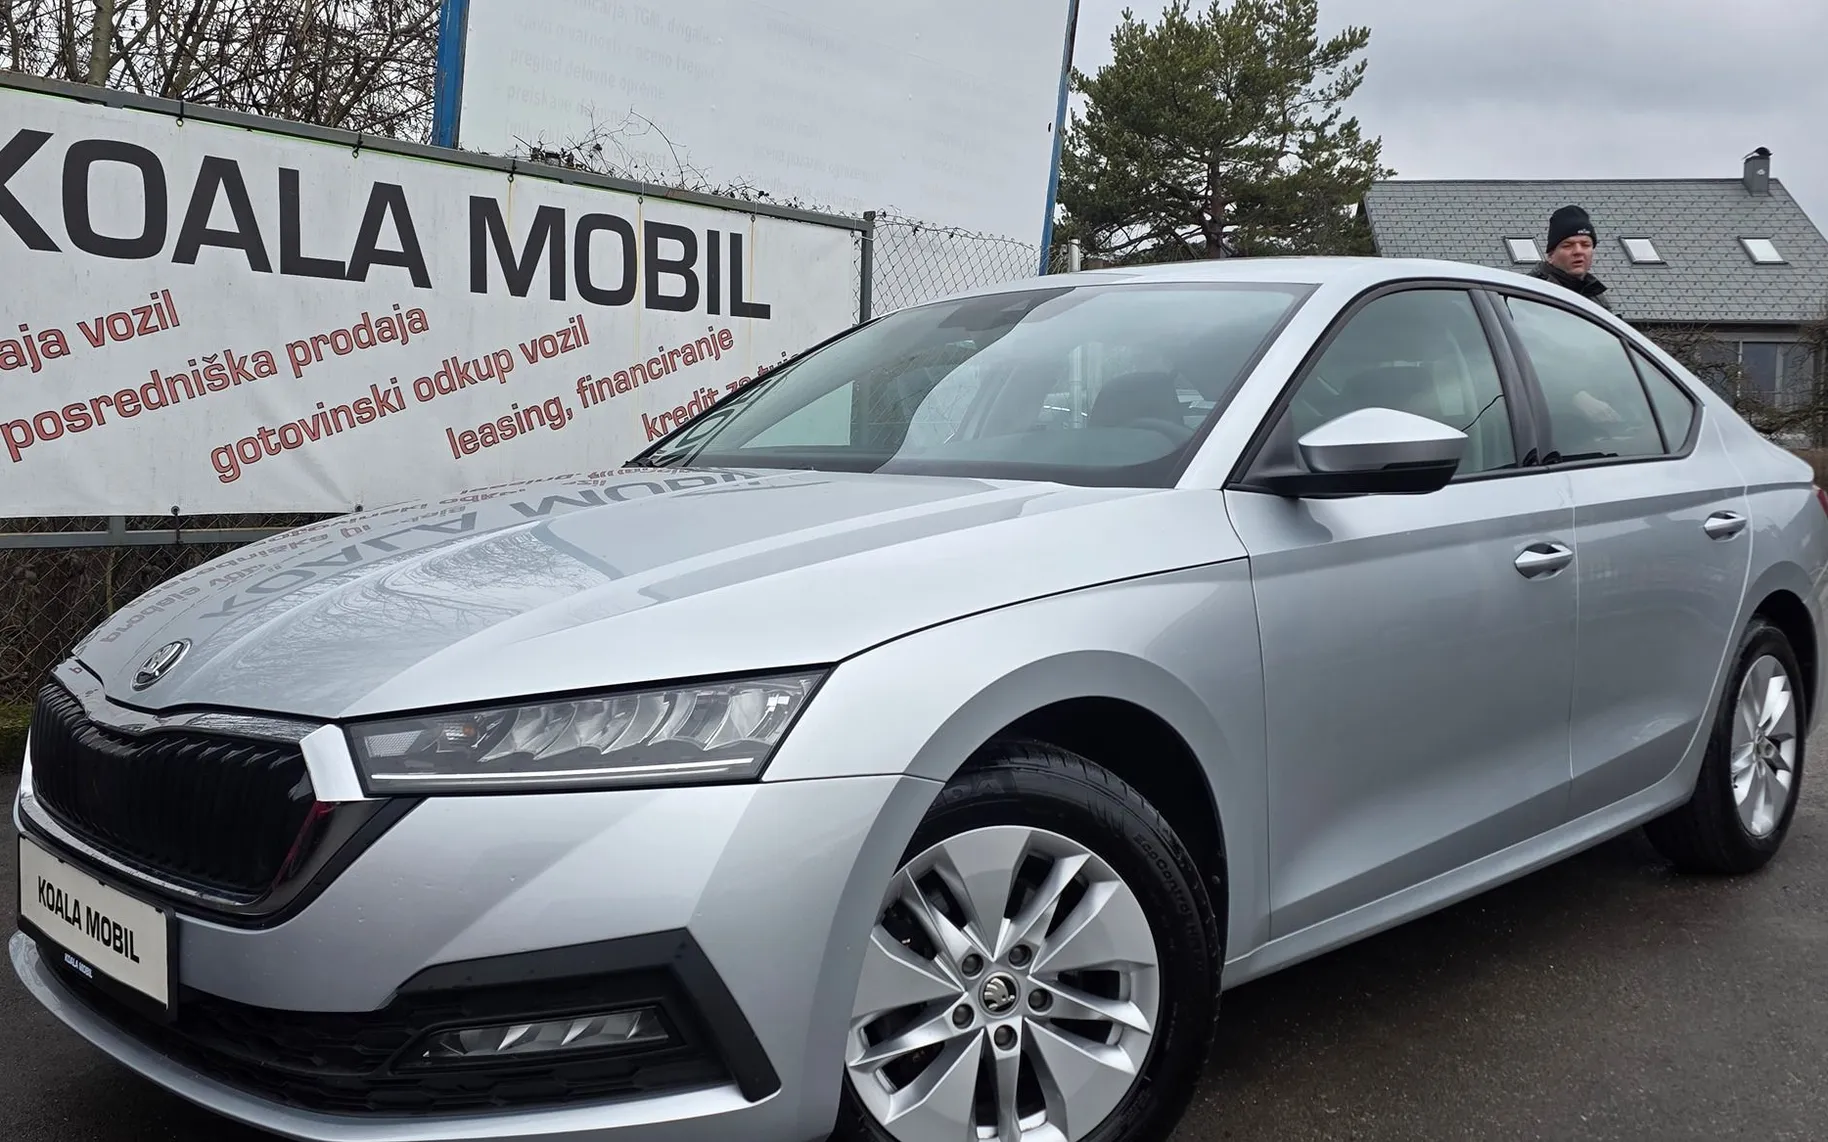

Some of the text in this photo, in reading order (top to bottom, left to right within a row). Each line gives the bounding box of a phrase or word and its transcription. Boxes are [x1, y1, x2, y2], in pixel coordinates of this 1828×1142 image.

[0, 128, 771, 320] KOALA MOBIL
[0, 303, 430, 463] posredniška prodaja
[77, 288, 181, 350] vozil
[210, 376, 407, 484] gotovinski
[413, 347, 514, 404] odkup
[519, 314, 591, 365] vozil
[446, 325, 735, 460] leasing, financiranje
[641, 387, 719, 442] kredit
[37, 875, 140, 964] KOALA MOBIL
